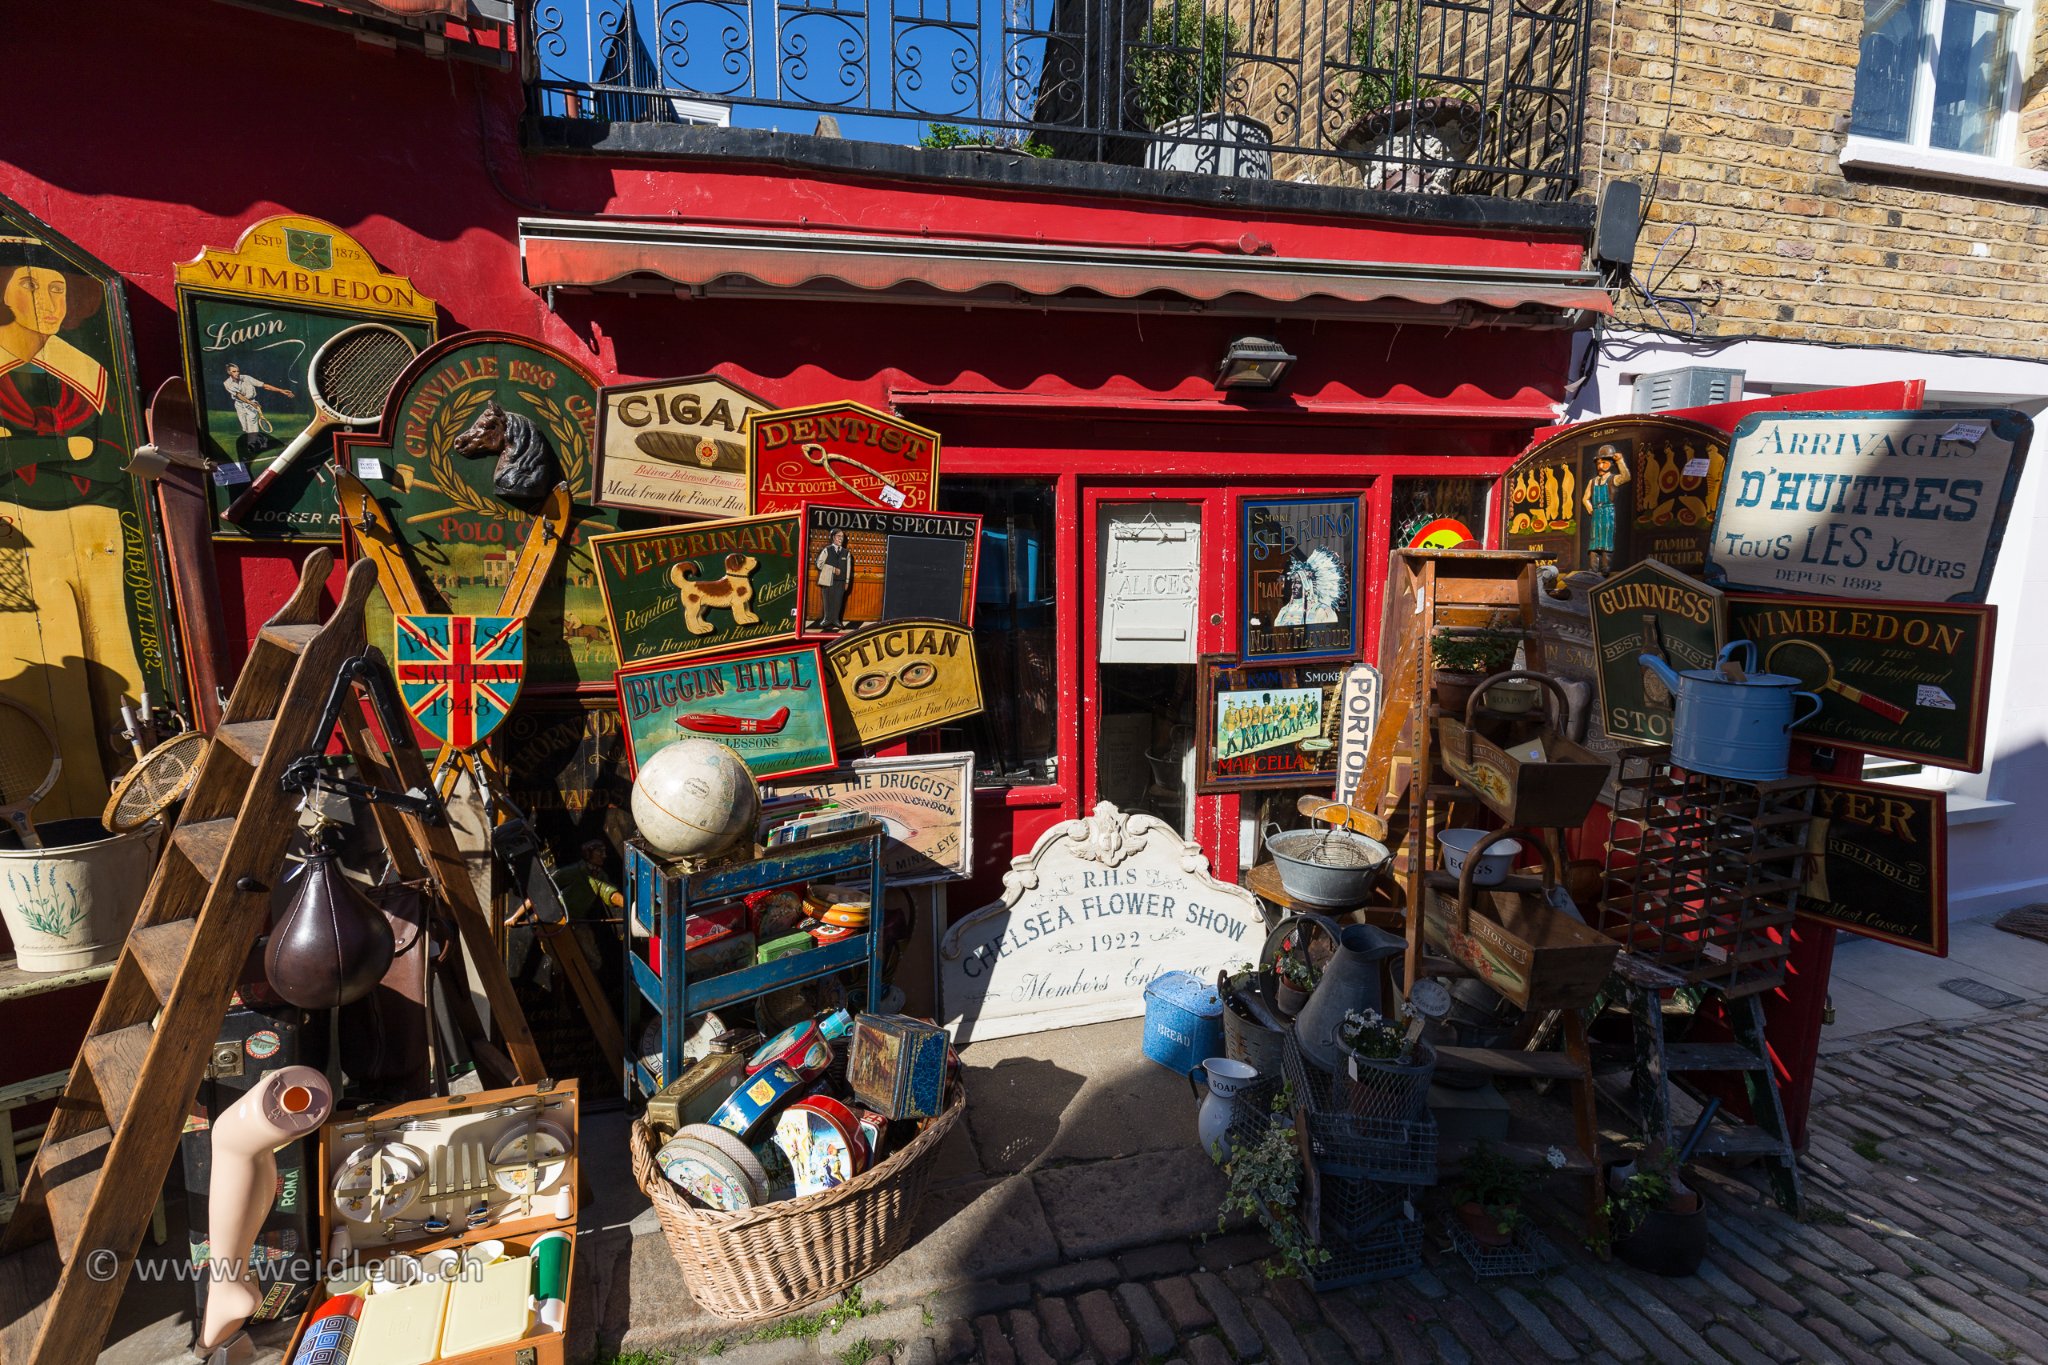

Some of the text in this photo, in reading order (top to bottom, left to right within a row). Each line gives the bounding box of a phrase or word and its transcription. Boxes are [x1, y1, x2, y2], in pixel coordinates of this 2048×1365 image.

[335, 248, 361, 260] 1875
[206, 260, 414, 307] WIMBLEDON
[202, 319, 286, 351] Lawn
[405, 357, 499, 457] GRANVILLE
[761, 416, 927, 461] DENTIST
[1752, 424, 1977, 458] ARRIVAGES
[603, 480, 638, 498] Made
[639, 485, 667, 502] from
[668, 489, 687, 503] the
[686, 491, 723, 507] Finest
[760, 473, 794, 493] ANY
[797, 480, 837, 493] TOOTH
[902, 471, 929, 482] ONLY
[1735, 467, 1984, 522] D'HUITRES
[253, 509, 322, 524] LOCKER
[815, 510, 975, 537] TODAY'S SPECIALS
[438, 519, 580, 545] POLO CB
[1281, 513, 1350, 555] BRUNO
[1655, 537, 1699, 551] FAMILY
[605, 522, 797, 580] VETERINARY
[1800, 523, 1873, 568] LES
[1877, 535, 1966, 580] JOURS
[1117, 575, 1193, 595] ALICES
[1254, 569, 1285, 614] FLAKE
[1775, 568, 1882, 592] DEPUIS 1892
[624, 574, 798, 633] Regular Checks
[1600, 583, 1712, 625] GUINNESS
[401, 623, 521, 655] BRITISH
[634, 617, 797, 657] For Happy and Healthy Pe
[1251, 629, 1294, 652] NUTTY
[1737, 609, 1965, 655] WIMBLEDON
[1604, 635, 1714, 670] BEST IRISH
[1880, 647, 1915, 661] THE
[404, 664, 521, 684] SKI TEAM
[1413, 636, 1425, 722] PROPERTY
[1841, 656, 1952, 684] All England
[626, 656, 812, 720] BIGGIN HILL
[432, 697, 491, 717] 1948
[875, 715, 900, 733] Made
[904, 707, 922, 722] with
[922, 702, 941, 717] Fine
[944, 695, 971, 711] Optics
[1613, 707, 1675, 737] STO
[1834, 717, 1899, 744] Croquet
[1901, 728, 1943, 750] Club
[726, 736, 780, 749] LESSONS
[1412, 730, 1421, 752] OF
[791, 751, 825, 768] Pilots
[1217, 754, 1306, 775] MARCELLA
[843, 774, 872, 793] THE
[880, 773, 955, 800] DRUGGIST
[1411, 759, 1421, 799] THE
[903, 795, 956, 816] LONDON
[937, 832, 959, 852] EYE
[1082, 868, 1138, 889] R.H.S
[1828, 839, 1922, 889] RELIABLE
[1826, 901, 1863, 922] Most
[962, 892, 1249, 979] CHELSEA FLOWER SHOW
[1091, 930, 1141, 952] 1922
[1482, 924, 1521, 961] HOUSE
[1156, 1022, 1191, 1048] BREAD
[1211, 1079, 1238, 1093] SOAP
[281, 1169, 300, 1208] ROMA
